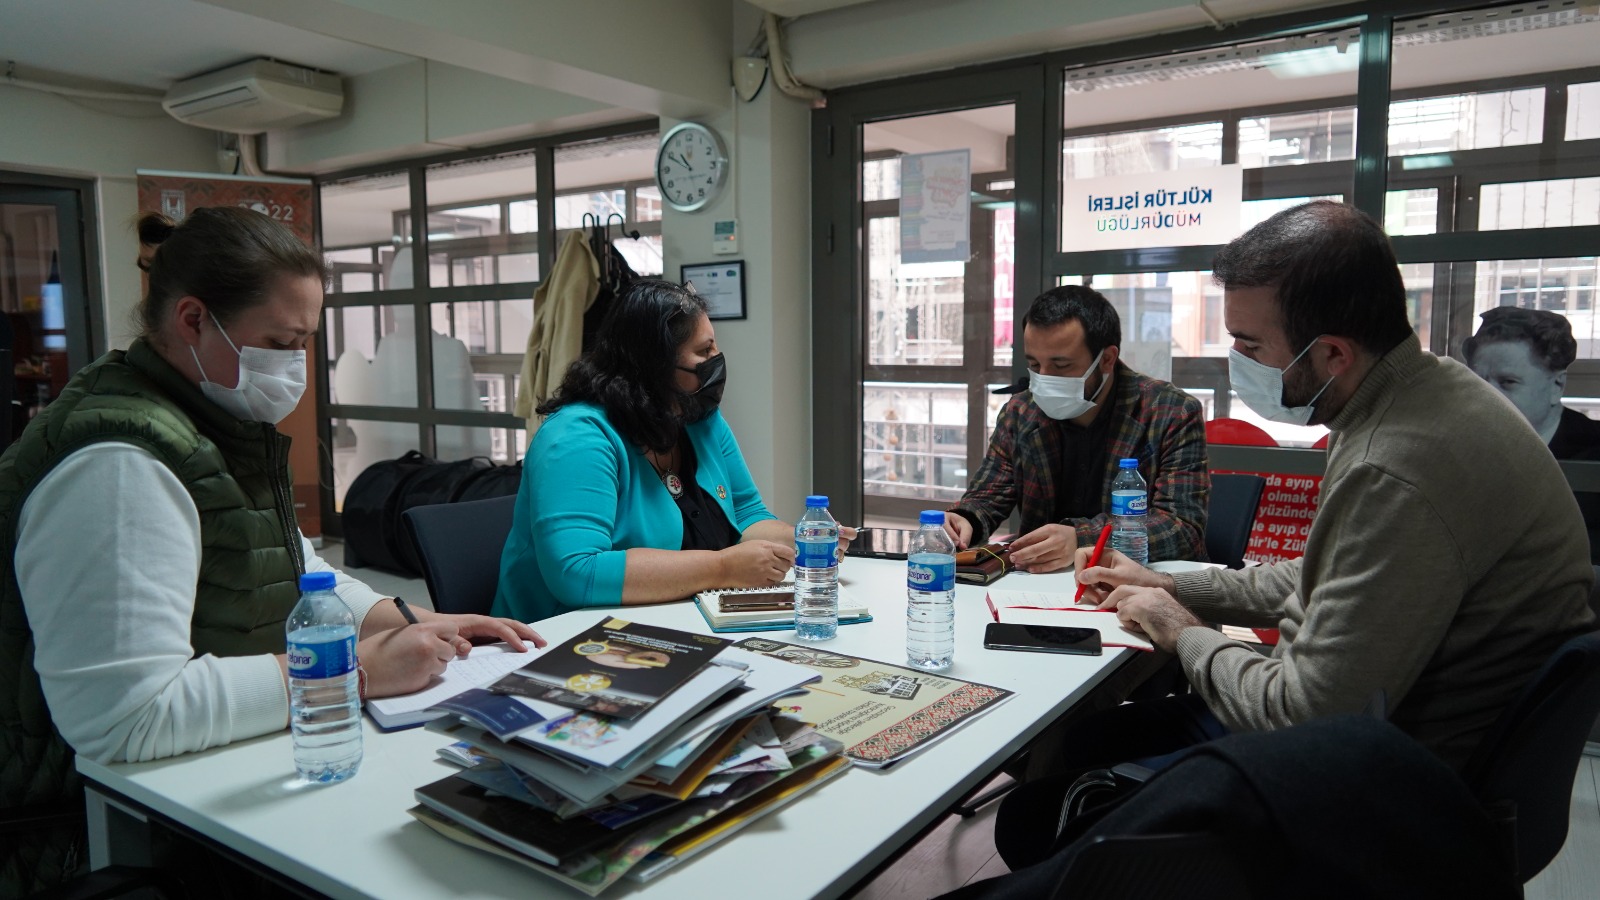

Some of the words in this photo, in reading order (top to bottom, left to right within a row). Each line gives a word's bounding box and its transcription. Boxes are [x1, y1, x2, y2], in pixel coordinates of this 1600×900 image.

[1285, 477, 1314, 490] ayıp
[1267, 490, 1308, 504] olmak
[1259, 504, 1318, 519] yüzünde
[1268, 523, 1297, 536] ayıp
